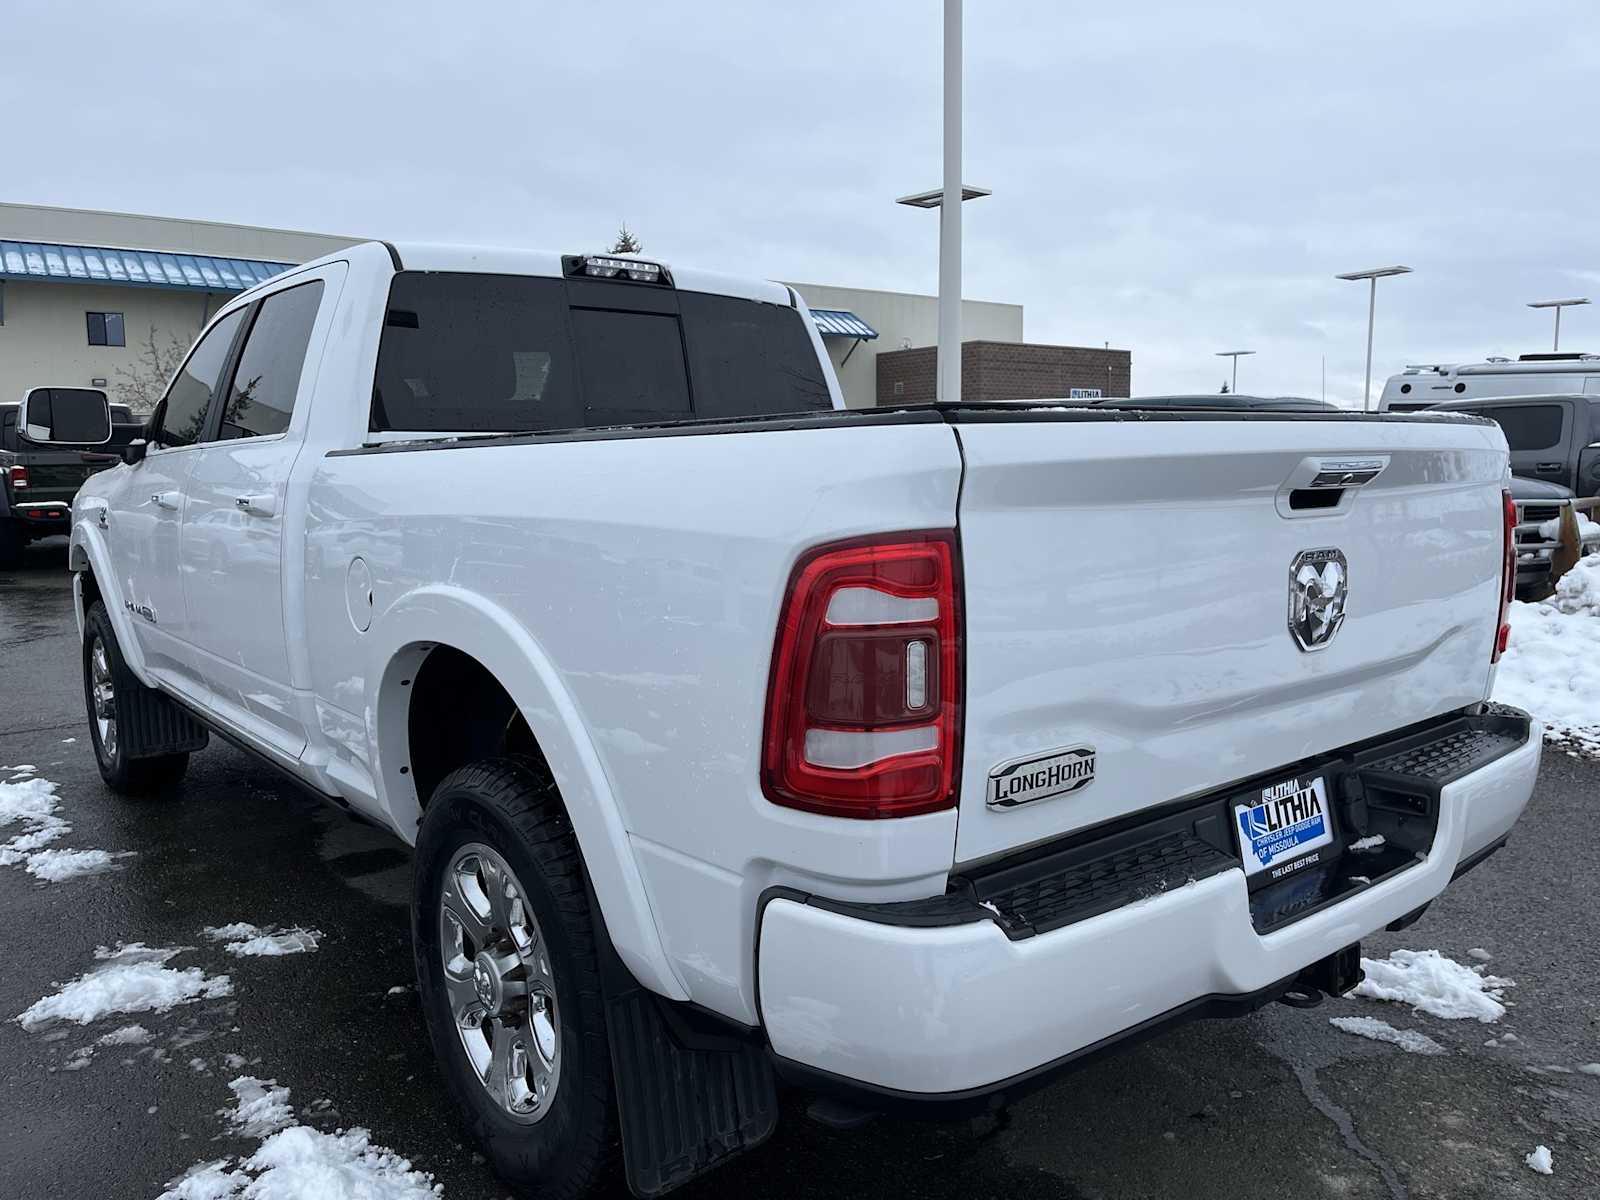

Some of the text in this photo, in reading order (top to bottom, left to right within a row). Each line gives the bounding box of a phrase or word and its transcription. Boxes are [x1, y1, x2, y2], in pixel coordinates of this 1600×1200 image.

[995, 758, 1095, 801] LONGHORN
[1270, 779, 1300, 798] LITHIA
[1265, 788, 1322, 832] LITHIA
[1258, 836, 1299, 859] OF MISSOULA
[1272, 853, 1320, 879] THE LAST BEST PRICE
